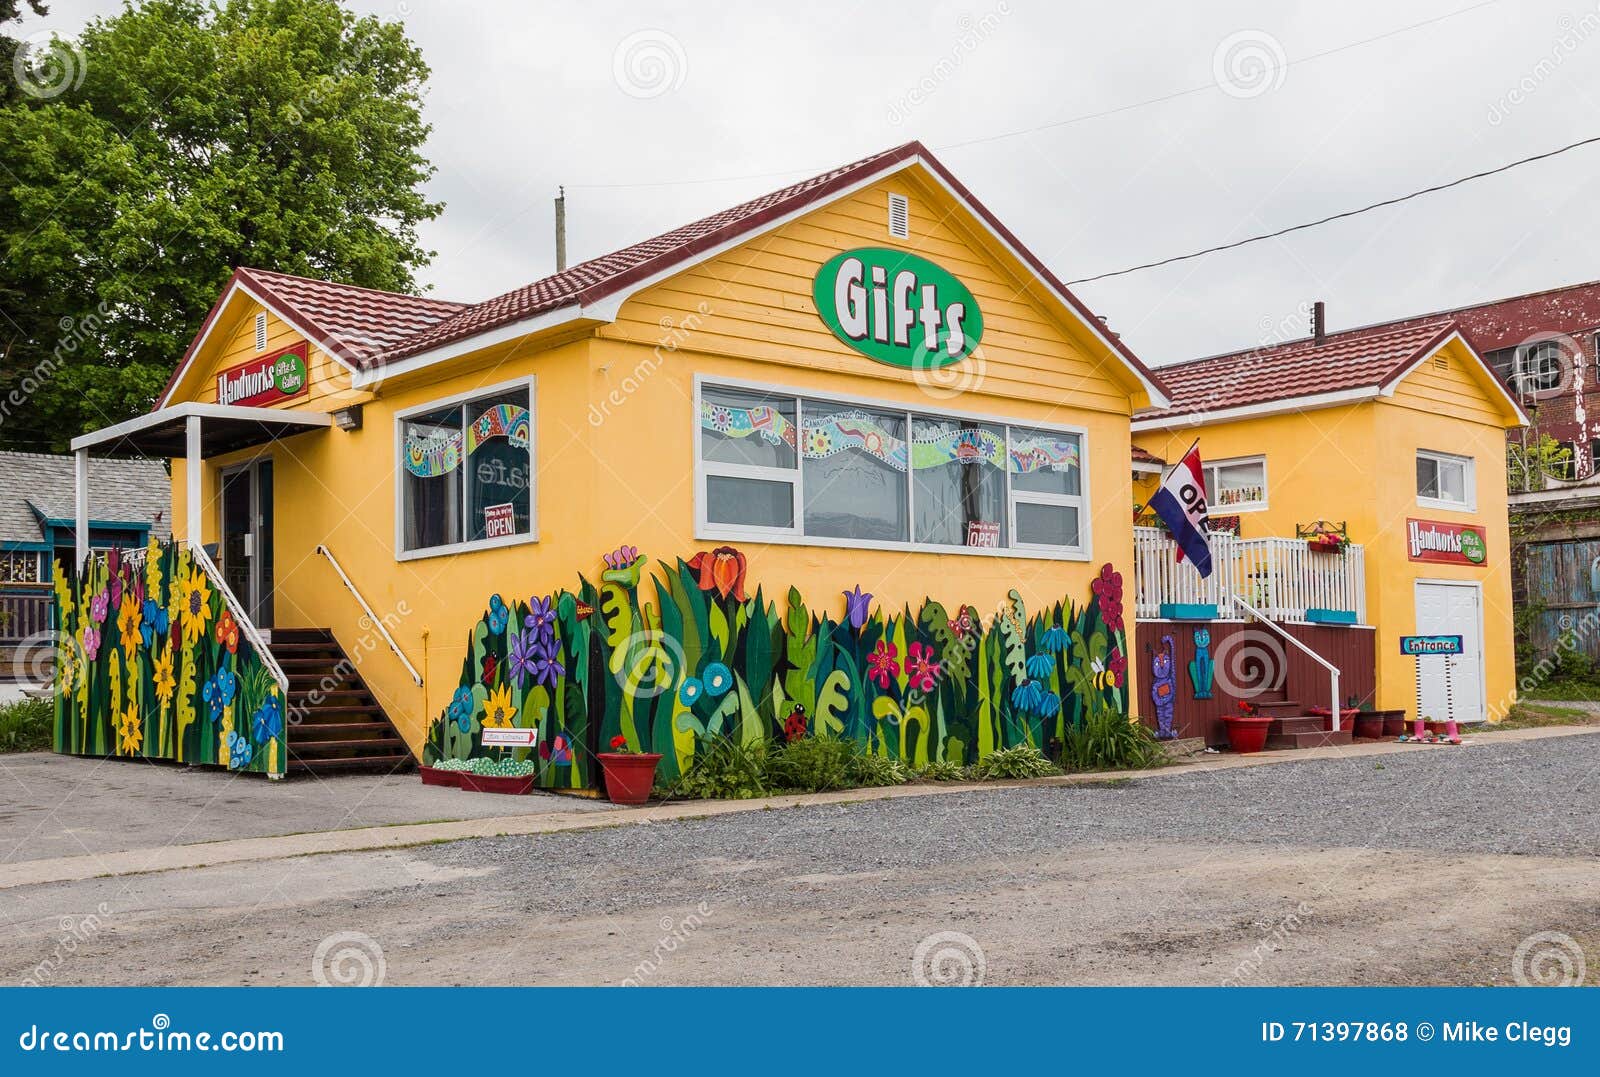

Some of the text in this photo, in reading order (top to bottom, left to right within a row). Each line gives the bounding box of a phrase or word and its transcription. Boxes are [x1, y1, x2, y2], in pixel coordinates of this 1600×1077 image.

[834, 257, 965, 357] Gifts
[218, 364, 275, 405] Handworks
[488, 516, 513, 537] OPEN
[970, 531, 998, 548] OPEN
[1408, 521, 1461, 556] Handworks
[1409, 639, 1455, 652] Entrance
